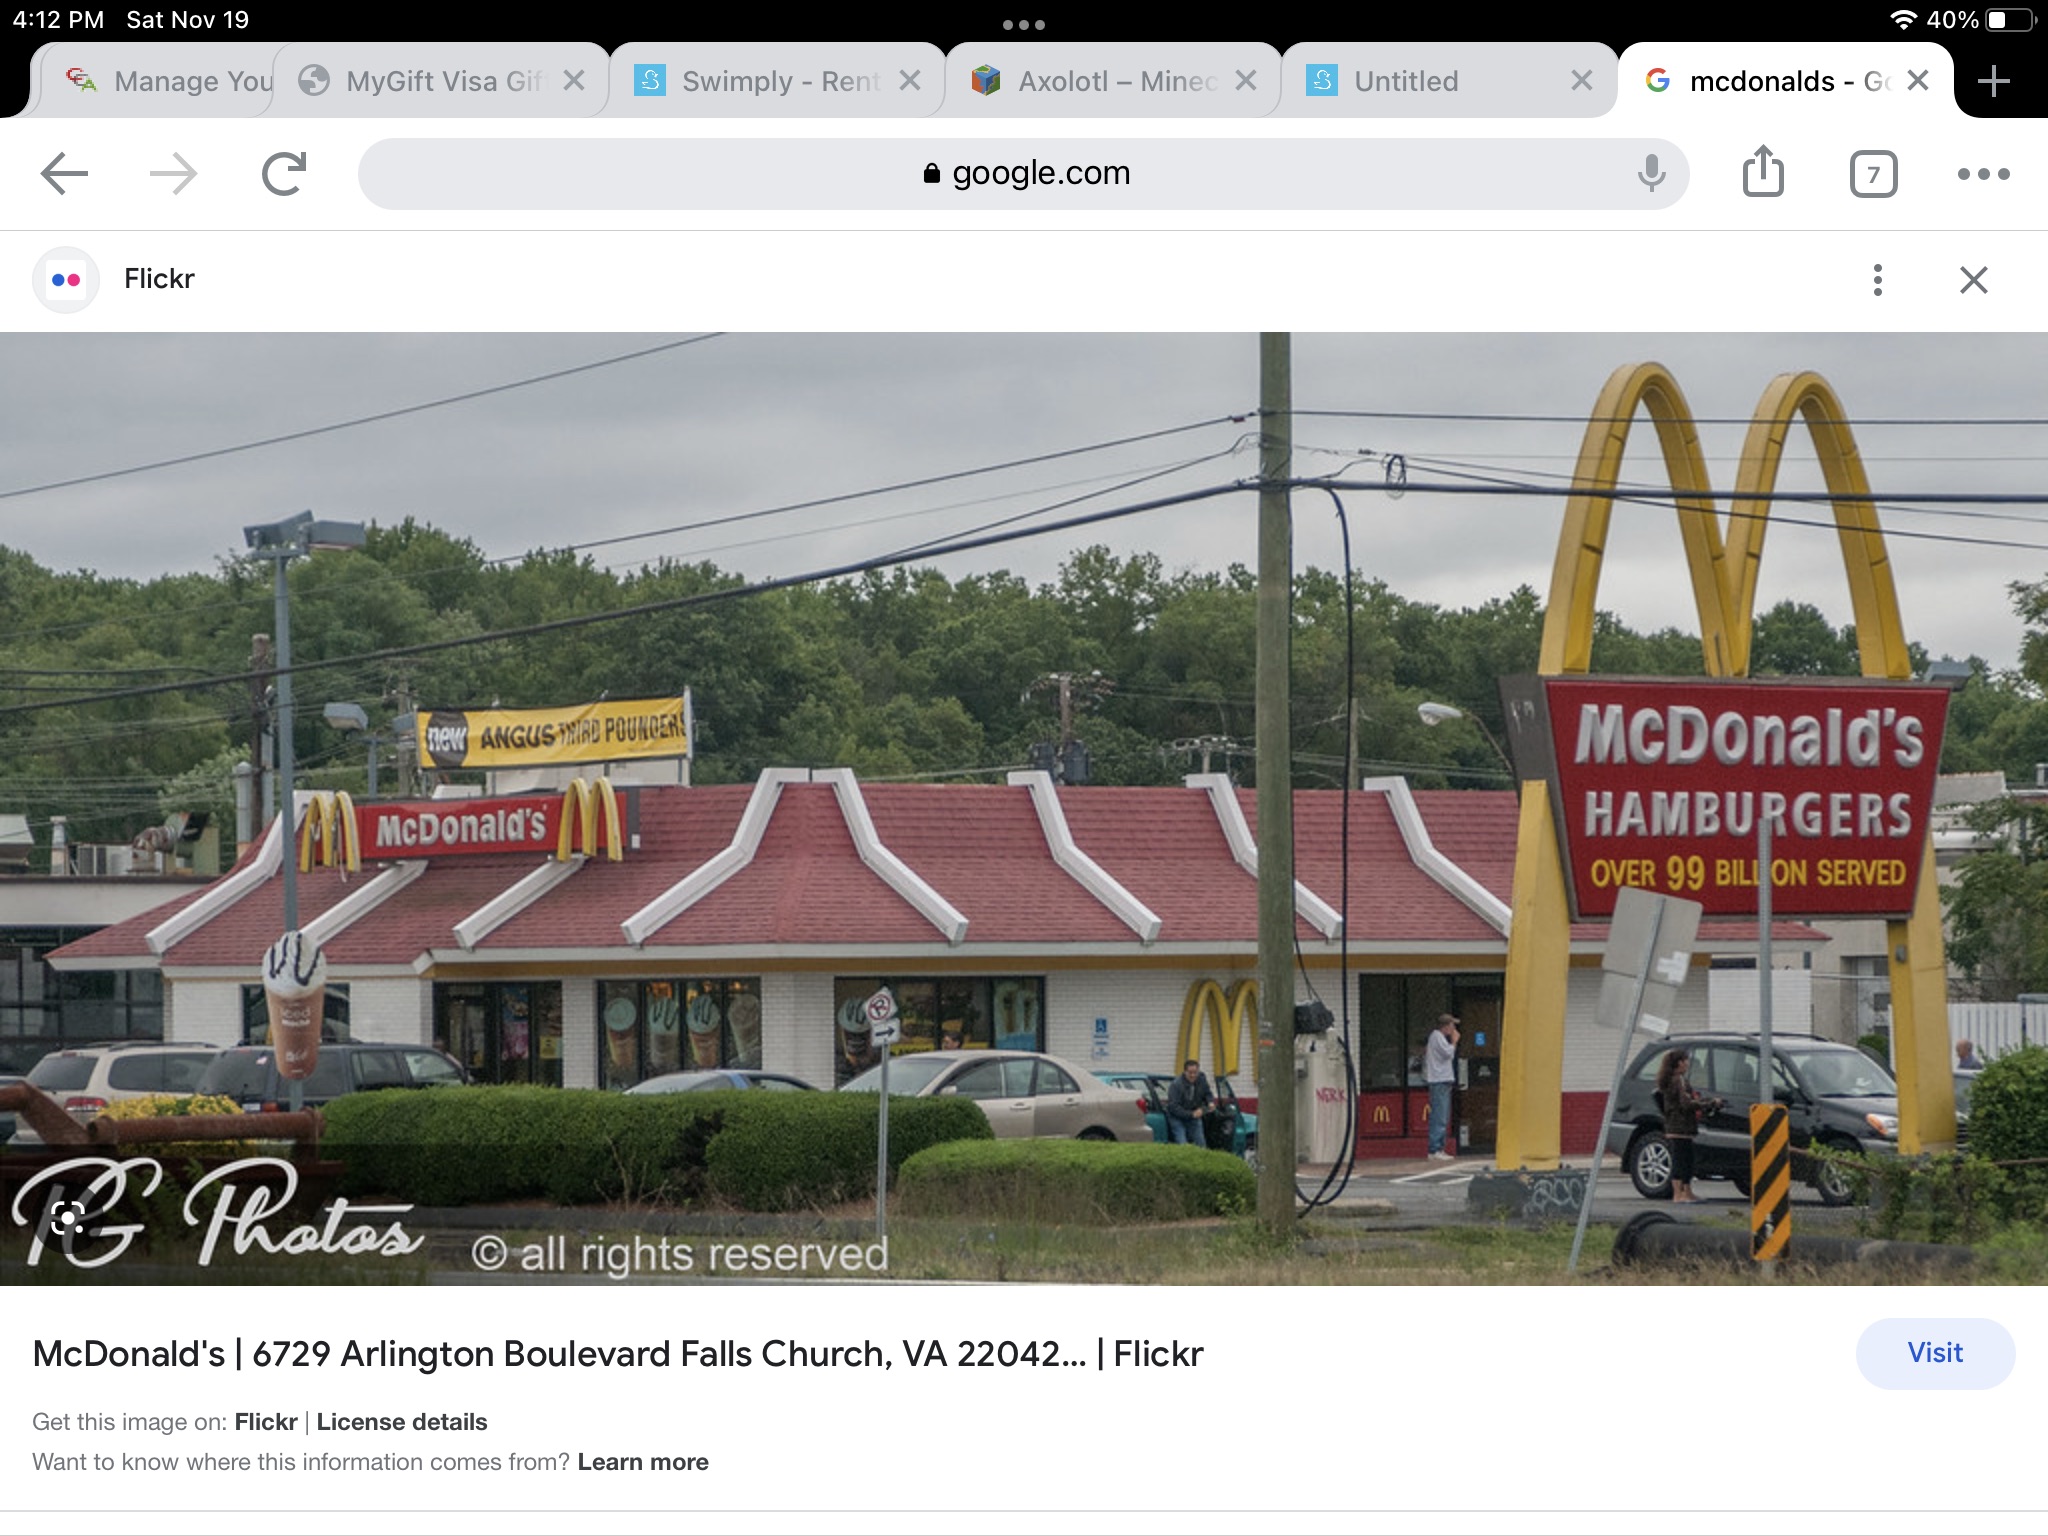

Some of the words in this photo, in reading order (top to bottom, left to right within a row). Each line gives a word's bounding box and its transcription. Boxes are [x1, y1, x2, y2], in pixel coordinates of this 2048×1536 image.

[13, 10, 60, 28] 4:12
[70, 11, 103, 28] PM
[127, 10, 163, 29] Sat
[172, 11, 215, 29] Nov
[224, 10, 249, 29] 19
[1927, 10, 1979, 29] 40%
[116, 70, 218, 97] Manage
[348, 70, 434, 97] MyGift
[442, 70, 497, 92] Visa
[507, 70, 548, 92] Gif
[683, 70, 793, 97] Swimply
[823, 70, 881, 92] Rent
[1019, 70, 1107, 92] Axolotl
[1142, 70, 1219, 92] Minec
[1356, 70, 1458, 92] Untitled
[1692, 70, 1835, 92] mcdonalds
[953, 159, 1129, 191] google.com
[1868, 166, 1881, 184] 7
[126, 267, 195, 289] Flickr
[427, 725, 468, 752] new
[480, 723, 556, 750] ANGUS
[1574, 703, 1925, 769] McDonald's
[1585, 791, 1912, 839] HAMBURGERS
[376, 806, 547, 848] McDonald's
[1591, 859, 1656, 888] OVER
[1667, 855, 1706, 892] 99
[1716, 859, 1808, 887] BILLON
[1817, 859, 1907, 887] SERVED
[35, 1339, 226, 1367] McDonald's
[253, 1340, 330, 1367] 6729
[340, 1339, 493, 1375] Arlington
[506, 1340, 669, 1367] Boulevard
[683, 1340, 752, 1367] Falls
[762, 1339, 892, 1371] Church,
[902, 1340, 948, 1366] VA
[958, 1340, 1086, 1367] 22042...
[1116, 1339, 1204, 1367] Flickr
[1908, 1341, 1964, 1363] Visit
[33, 1412, 70, 1431] Get
[77, 1413, 115, 1431] this
[123, 1413, 187, 1435] image
[195, 1417, 226, 1431] on:
[236, 1412, 298, 1431] Flickr
[318, 1412, 405, 1431] License
[412, 1412, 488, 1431] details
[32, 1453, 87, 1471] Want
[93, 1454, 115, 1471] to
[123, 1453, 179, 1471] know
[186, 1453, 251, 1471] where
[257, 1453, 296, 1471] this
[304, 1452, 422, 1471] information
[431, 1457, 502, 1471] comes
[508, 1452, 570, 1471] from?
[579, 1452, 642, 1471] Learn
[651, 1457, 709, 1471] more
